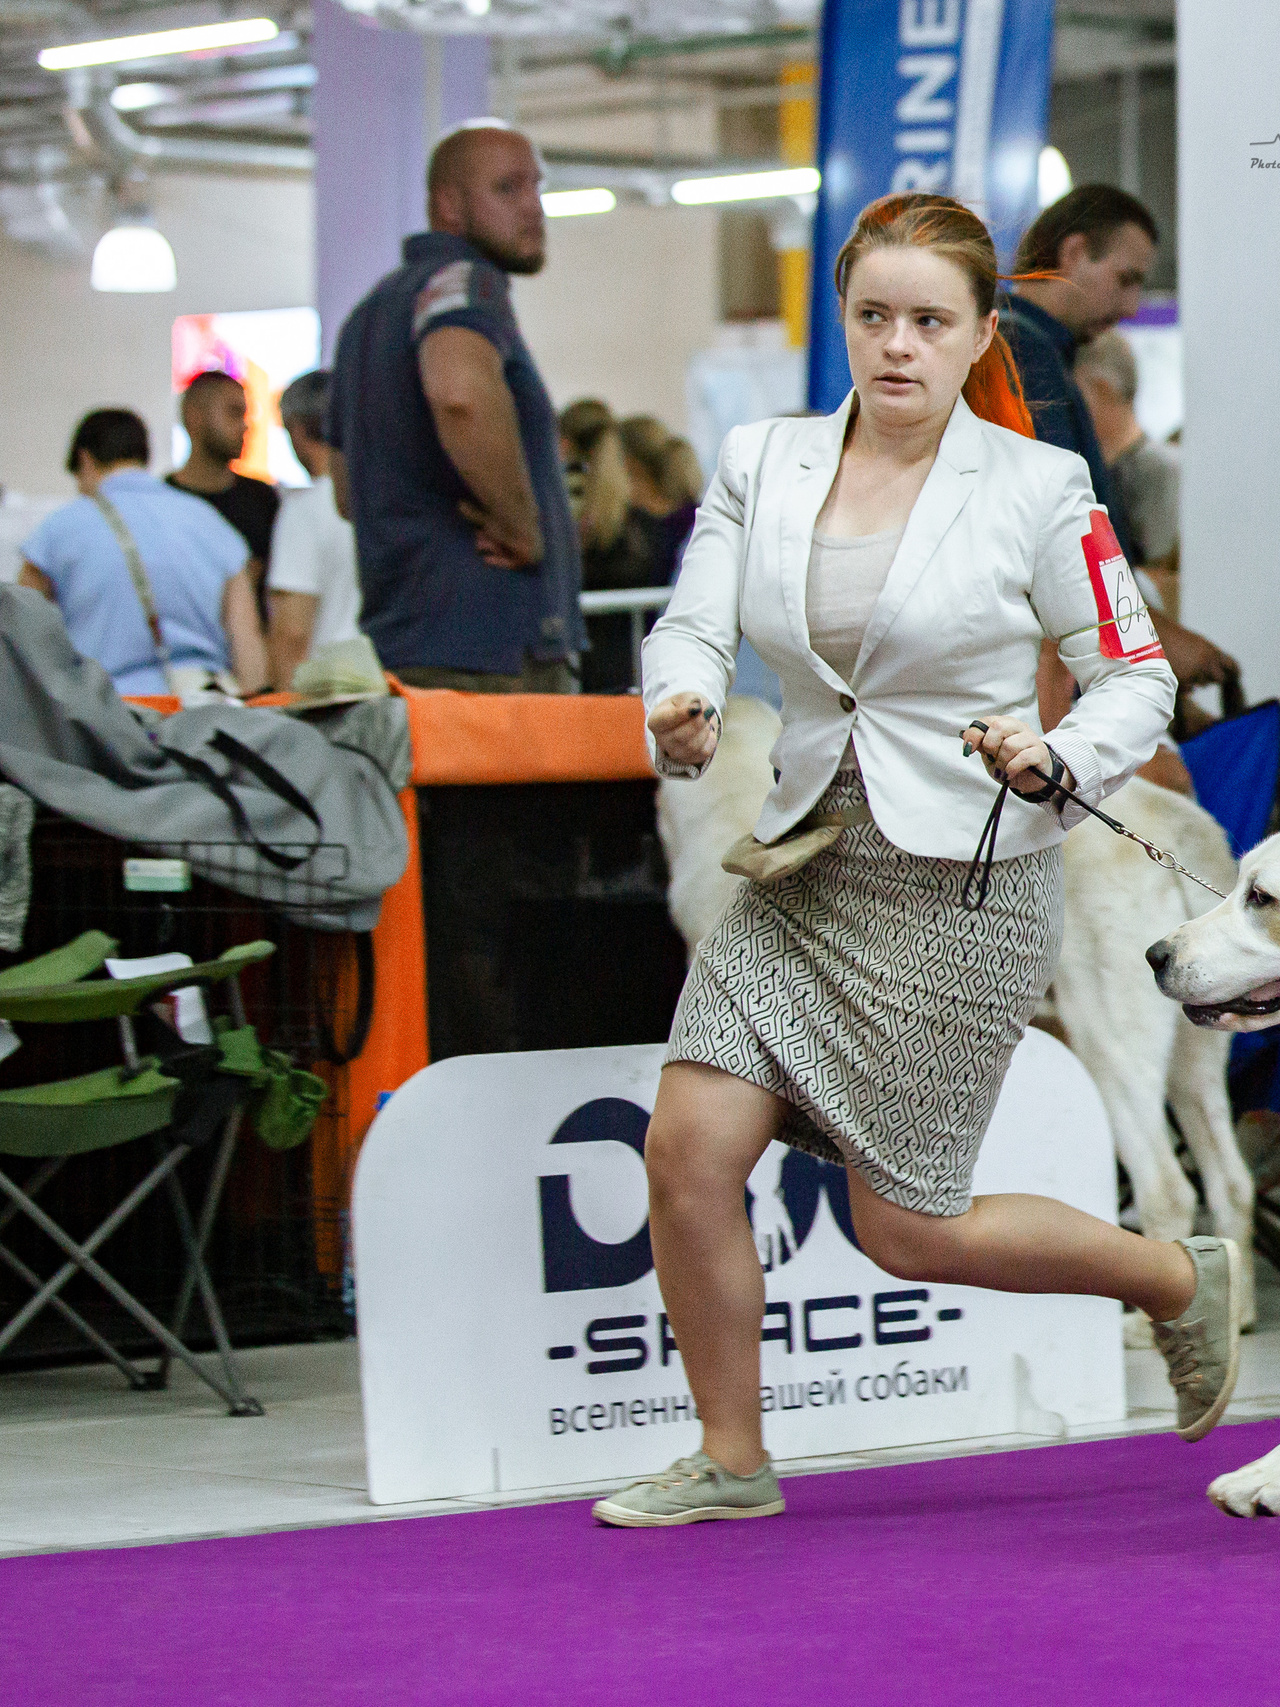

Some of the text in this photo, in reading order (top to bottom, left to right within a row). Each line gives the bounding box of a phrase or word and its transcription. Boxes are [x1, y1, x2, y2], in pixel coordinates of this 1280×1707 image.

[549, 1359, 969, 1436] вселенн ашей собаки
